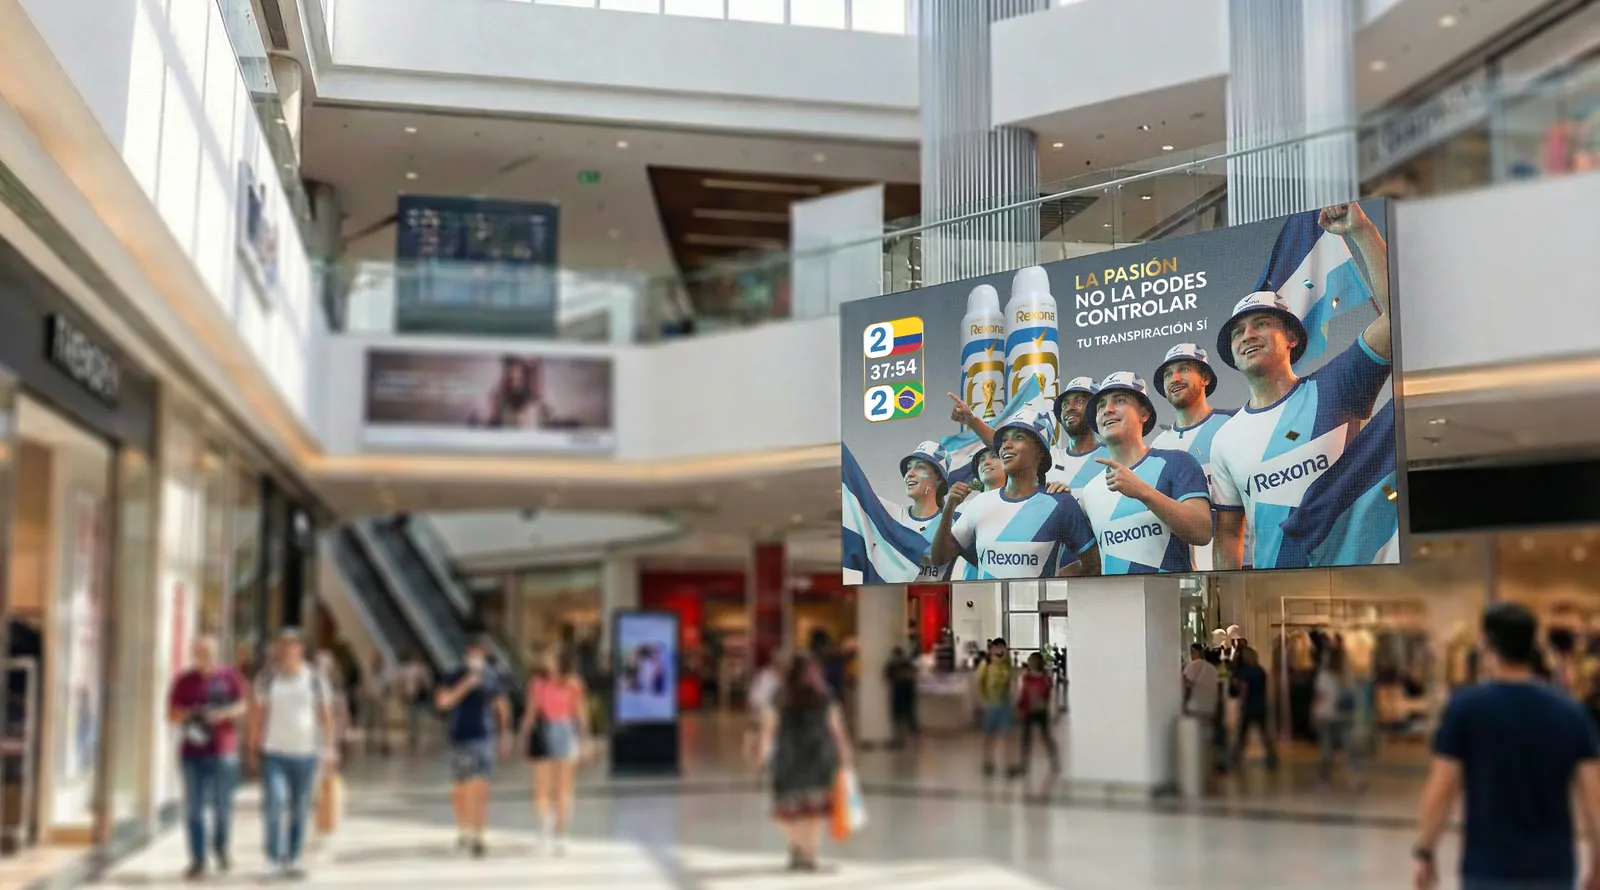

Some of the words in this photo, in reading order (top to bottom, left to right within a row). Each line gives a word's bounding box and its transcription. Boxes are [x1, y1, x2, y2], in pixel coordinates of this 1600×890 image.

[1076, 272, 1099, 290] LA
[1104, 257, 1177, 285] PASIÓN
[1076, 290, 1106, 309] NO
[1111, 285, 1136, 303] LA
[1141, 271, 1207, 298] PODES
[1016, 310, 1055, 323] Rexona
[1075, 293, 1198, 327] CONTROLAR
[870, 327, 887, 353] 2
[970, 324, 1004, 335] Rexona
[1077, 338, 1092, 349] TU
[1094, 321, 1193, 346] TRANSPIRACIÓN
[1196, 317, 1209, 331] SÍ
[870, 358, 917, 380] 37:54
[871, 390, 888, 416] 2
[1253, 453, 1330, 493] Rexona
[1104, 522, 1163, 546] Rexona
[919, 564, 939, 577] ona
[987, 549, 1039, 566] Rexona
